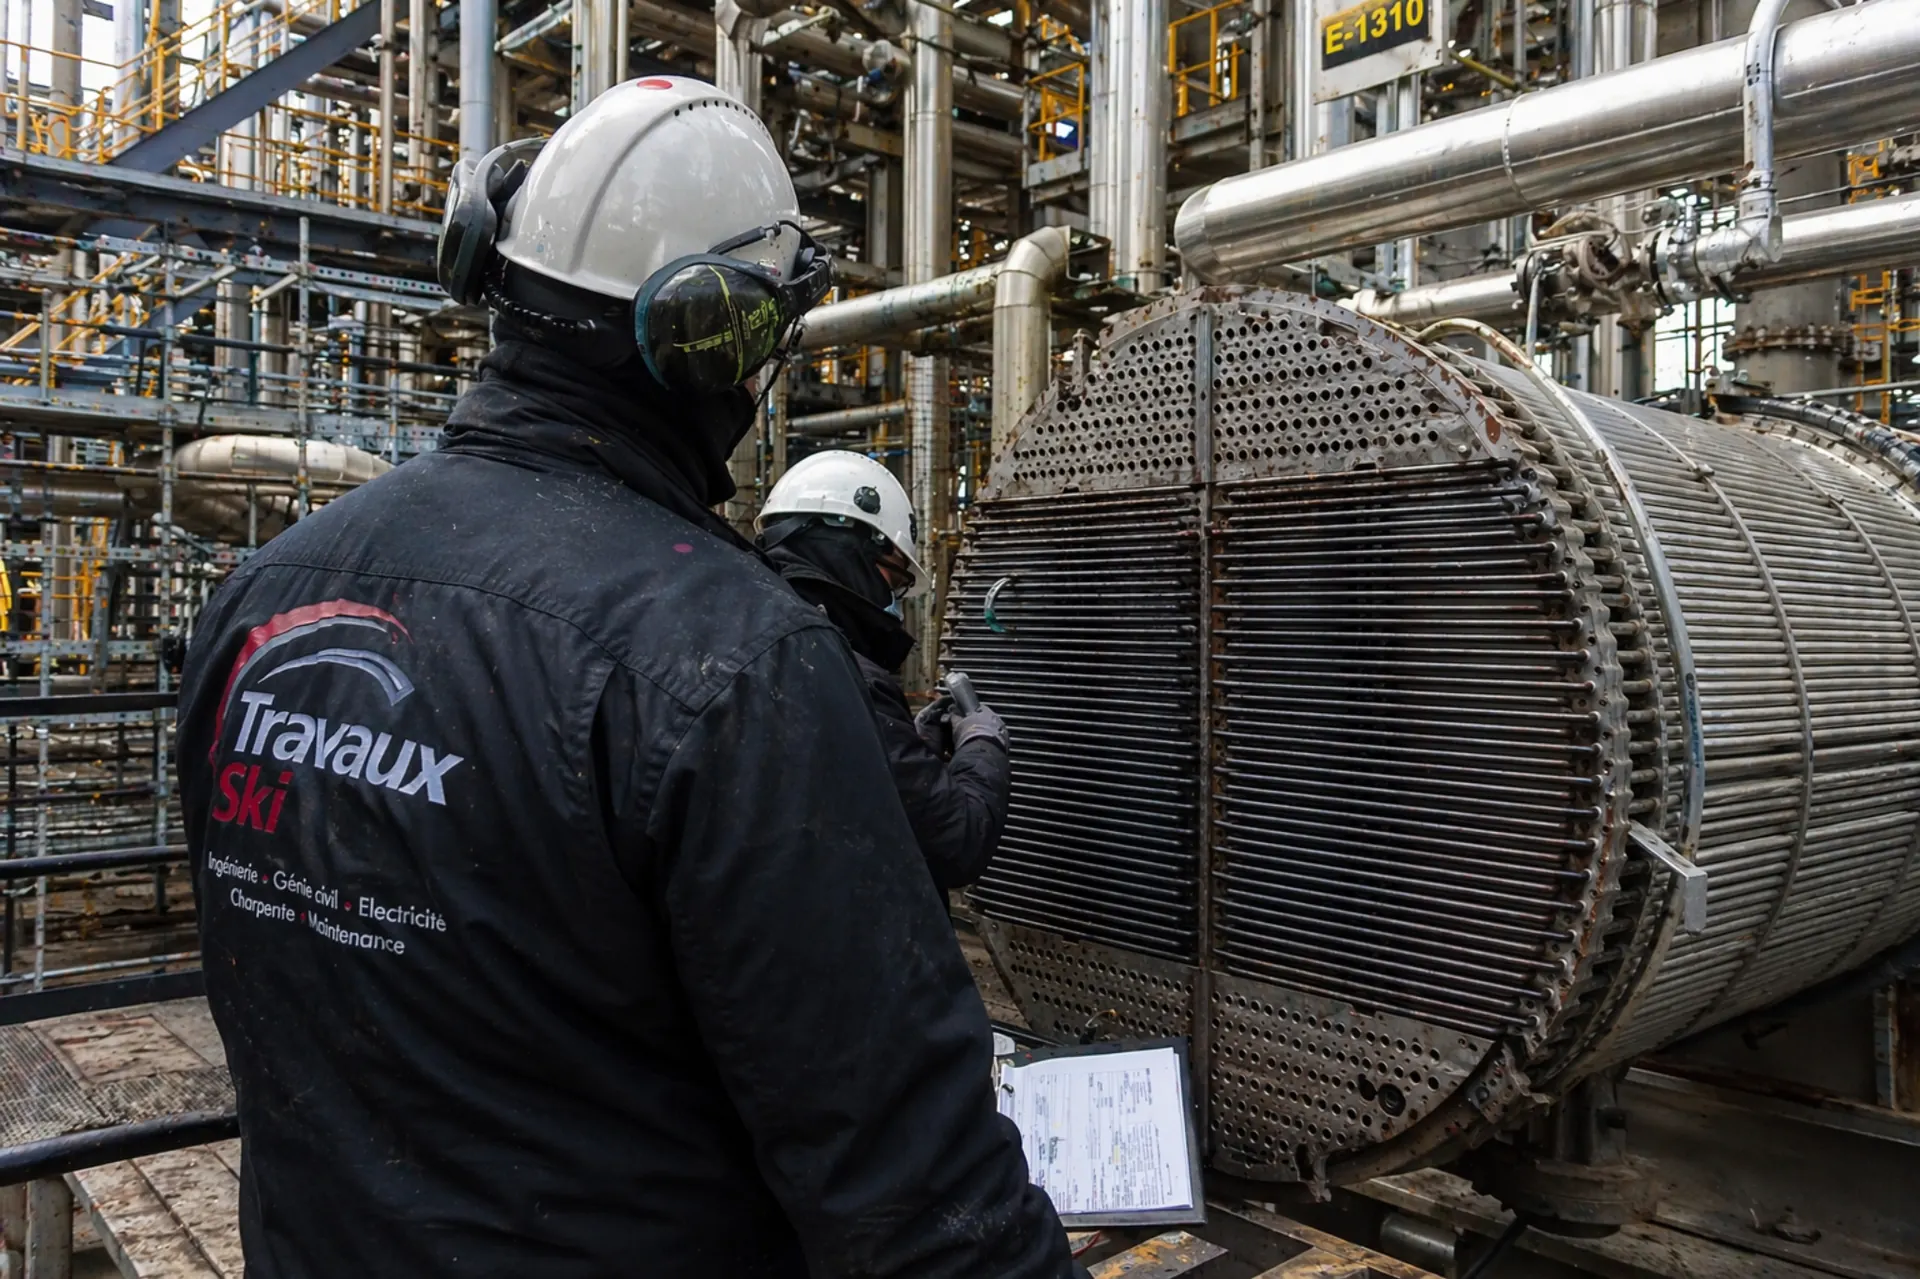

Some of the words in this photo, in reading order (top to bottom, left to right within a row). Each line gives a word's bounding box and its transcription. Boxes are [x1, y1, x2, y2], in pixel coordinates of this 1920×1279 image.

[1326, 0, 1424, 54] E-1310
[234, 691, 464, 805] Travaux
[213, 763, 292, 833] Ski
[208, 851, 258, 884] Ingénierie
[273, 871, 312, 900] Génie
[315, 884, 339, 910] civil
[359, 896, 447, 932] Electricité
[230, 888, 296, 922] Charpente
[308, 910, 405, 954] Maintenance
